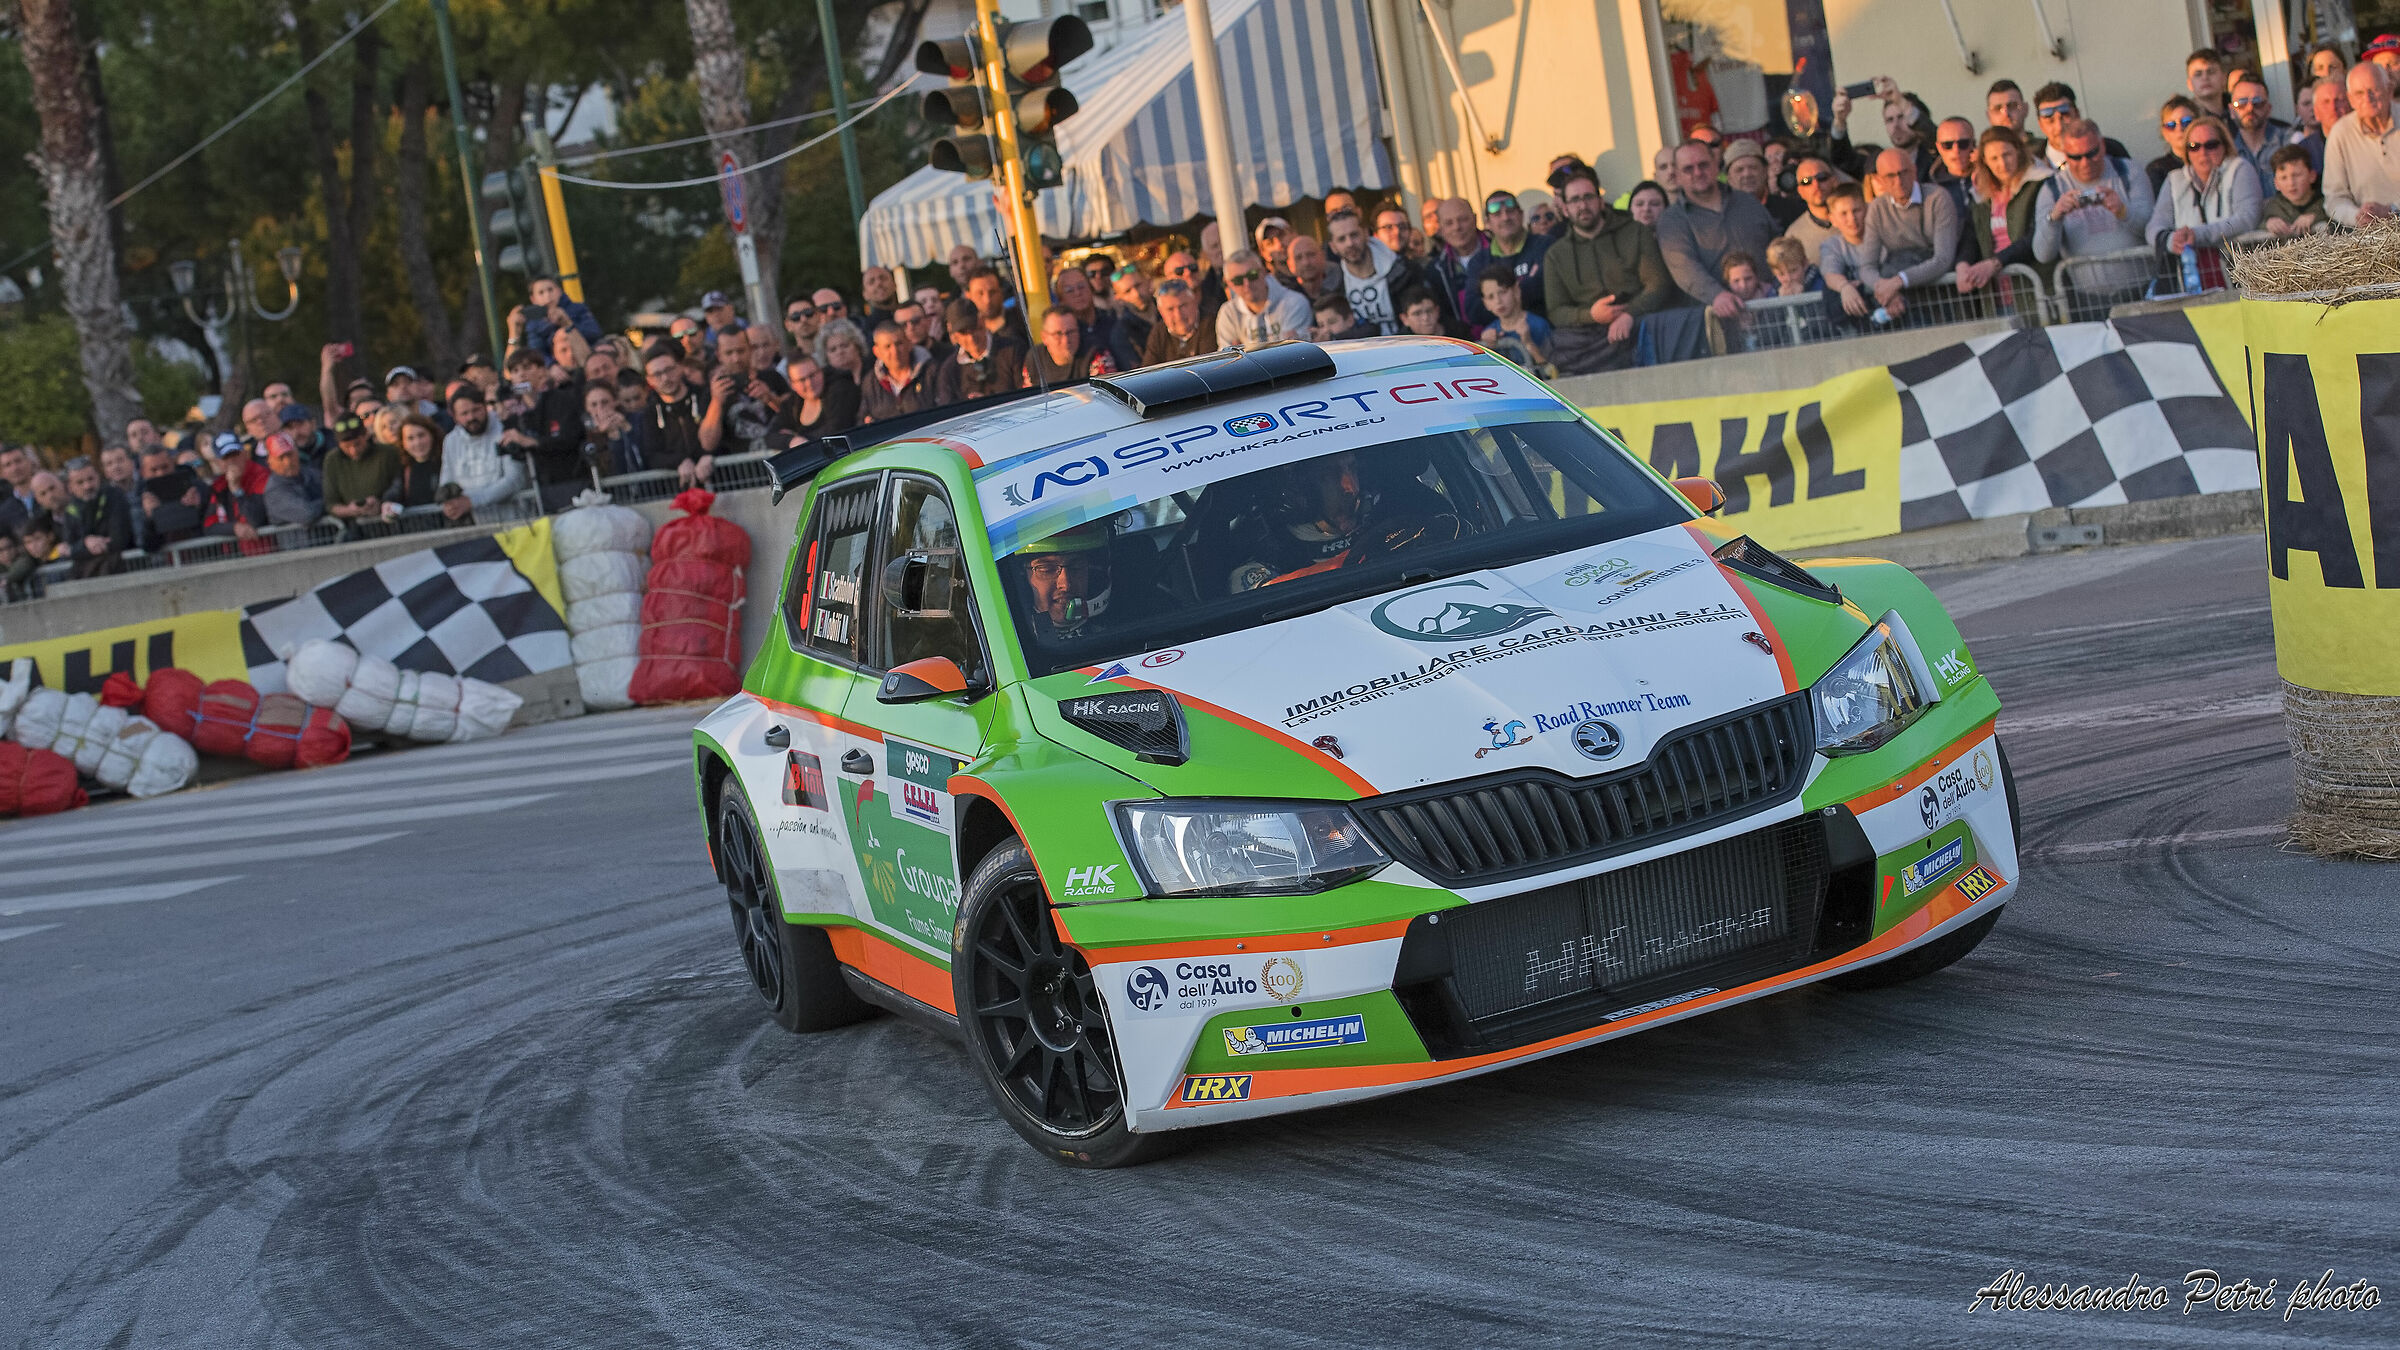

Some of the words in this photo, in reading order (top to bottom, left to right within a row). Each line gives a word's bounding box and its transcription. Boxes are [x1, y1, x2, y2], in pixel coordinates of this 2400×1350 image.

[1389, 376, 1506, 405] CIR
[1161, 415, 1388, 473] WWW.HKRACING.EU
[1322, 537, 1352, 553] HRX
[1597, 562, 1694, 606] CONCORRENTE
[1155, 653, 1172, 664] E
[1284, 702, 1344, 730] Lavori
[1347, 685, 1394, 710] edili,
[1397, 661, 1472, 695] stradali,
[1475, 635, 1578, 664] movimento
[1580, 629, 1626, 643] terra
[1628, 626, 1640, 637] e
[1642, 610, 1750, 635] demolizioni
[1285, 644, 1491, 718] IMMOBILIARE
[1498, 611, 1668, 650] CARDANINI
[1674, 603, 1740, 621] s.r.l.
[1934, 649, 1968, 680] HK
[1946, 665, 1972, 687] RACING
[1073, 700, 1104, 716] HK
[1107, 702, 1160, 715] RACING
[1534, 706, 1577, 734] Road
[1578, 696, 1643, 720] Runner
[1644, 692, 1692, 714] Team
[905, 749, 930, 775] gesco
[1978, 765, 1990, 781] 100
[1938, 766, 1963, 793] Casa
[1923, 843, 1962, 878] MICHELIN
[1066, 864, 1120, 887] HK
[1958, 867, 1995, 900] HRX
[1064, 885, 1116, 897] RACING
[1176, 962, 1231, 981] Casa
[1524, 925, 1628, 993] HK
[1269, 974, 1295, 987] 100
[1180, 999, 1195, 1010] dal
[1196, 998, 1217, 1009] 1919
[1266, 1021, 1361, 1044] MICHELIN
[1187, 1076, 1249, 1100] HRX
